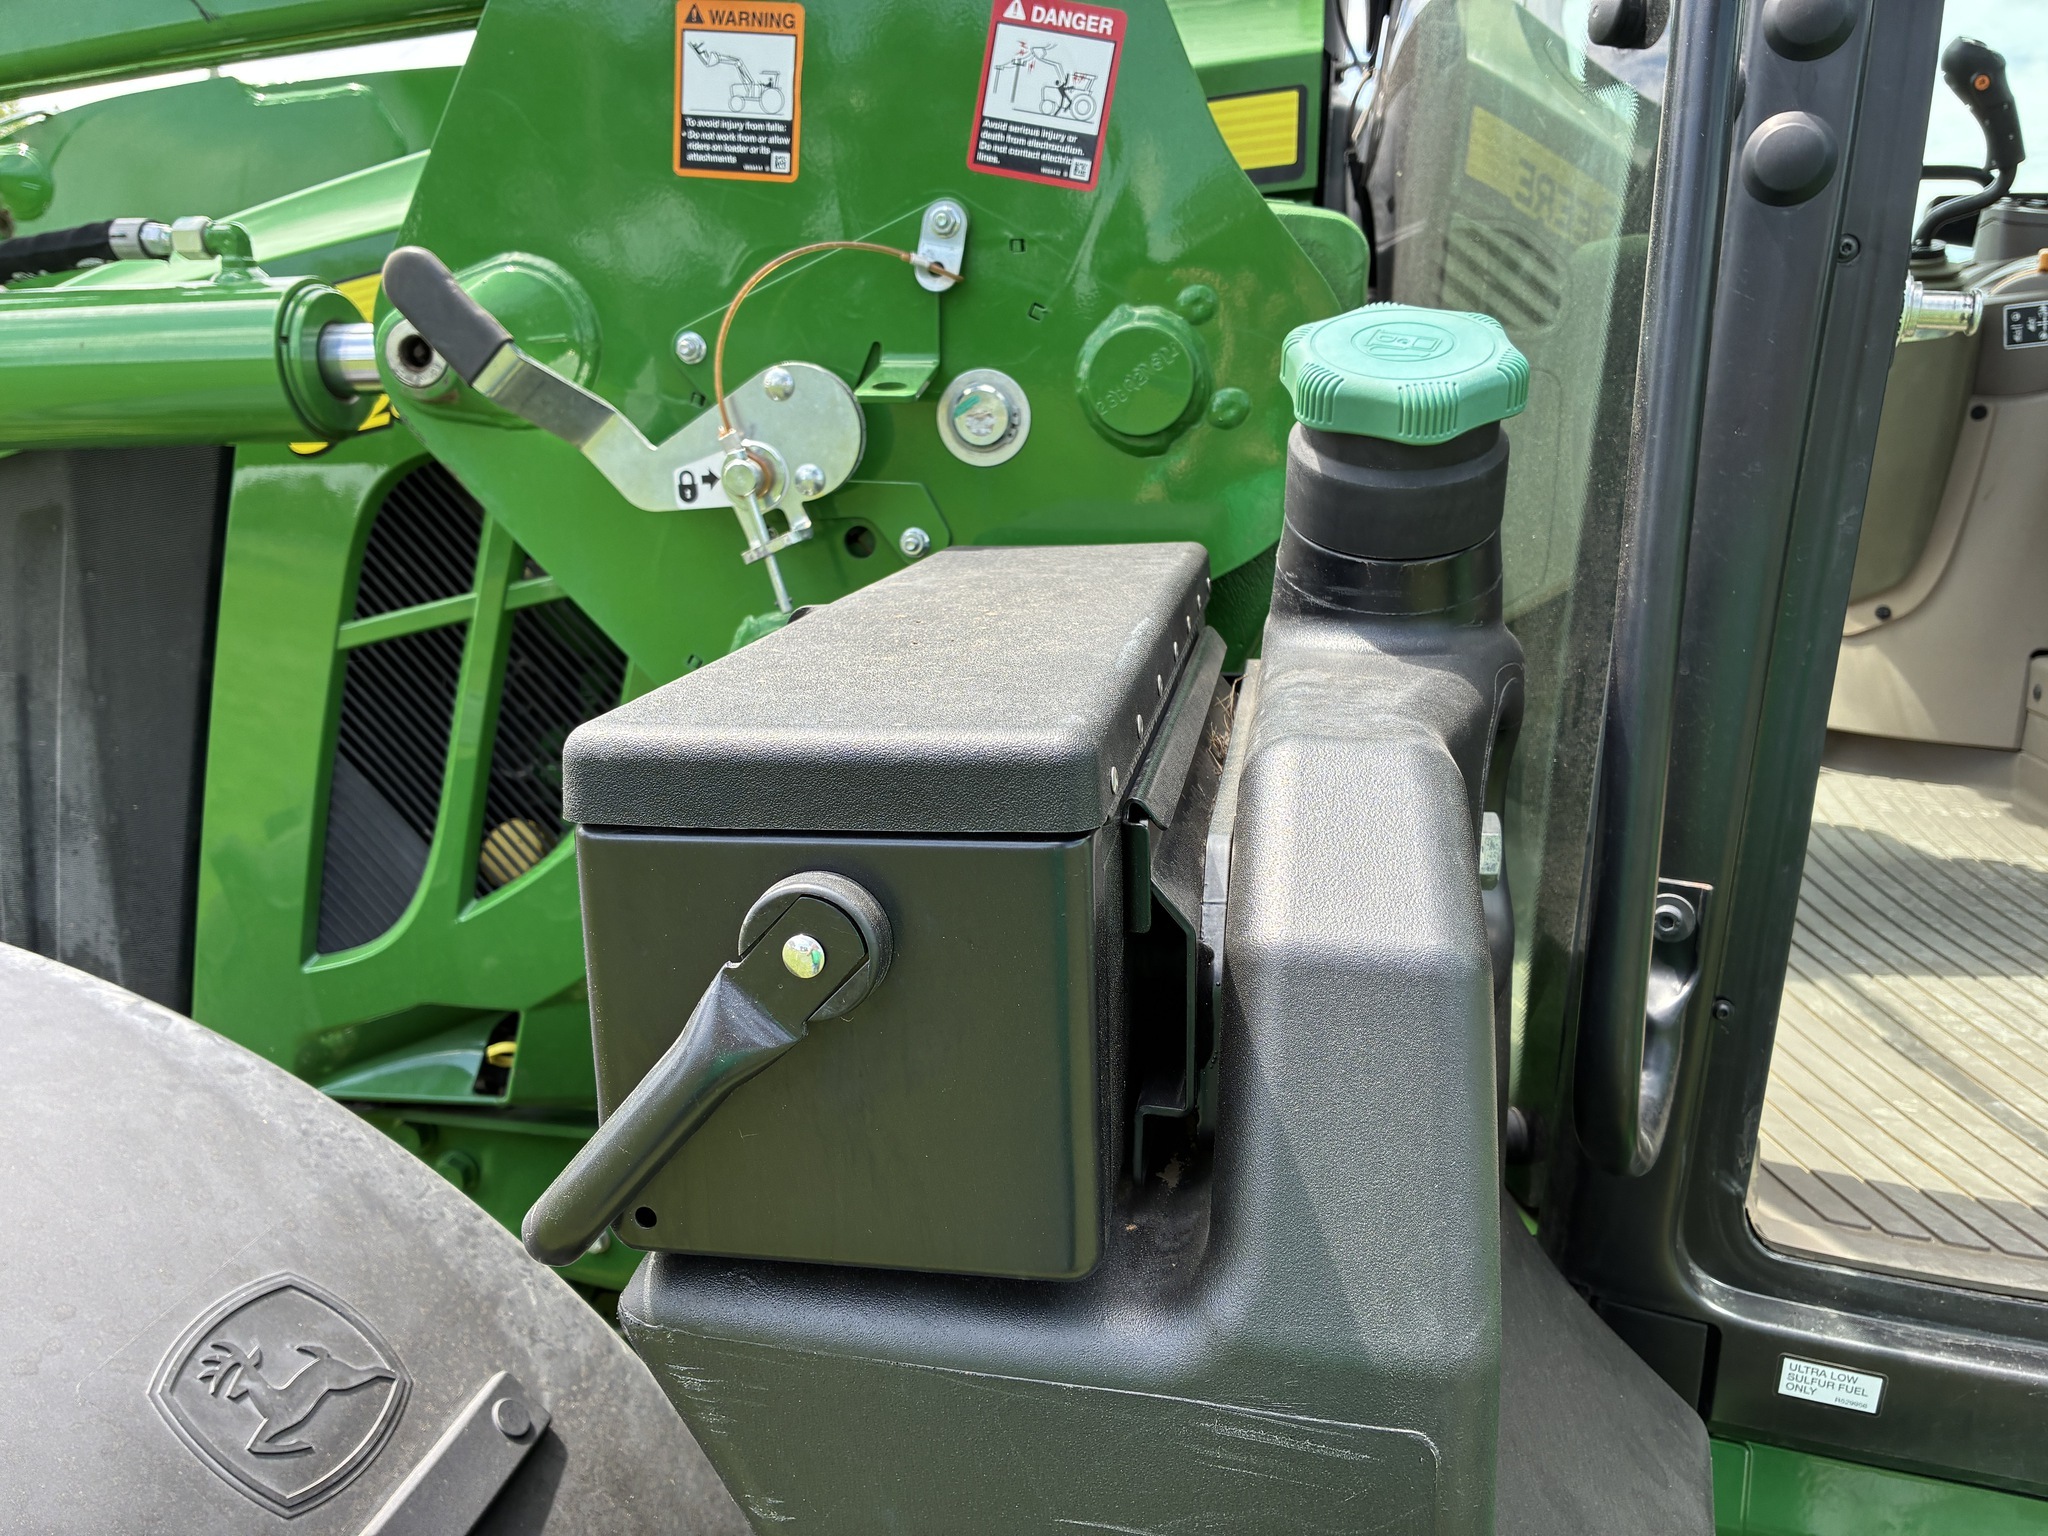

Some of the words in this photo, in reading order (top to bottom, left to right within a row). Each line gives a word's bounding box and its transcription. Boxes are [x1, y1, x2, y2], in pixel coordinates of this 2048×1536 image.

[708, 9, 796, 29] WARNING
[1031, 5, 1114, 35] DANGER
[684, 117, 696, 127] To
[697, 118, 720, 129] avoid
[721, 119, 744, 132] injury
[745, 121, 765, 131] from
[982, 119, 1007, 132] Avoid
[1008, 121, 1041, 137] serious
[1041, 126, 1066, 143] injury
[1067, 133, 1078, 143] or
[687, 130, 700, 140] Do
[701, 131, 715, 141] not
[716, 131, 736, 142] work
[737, 132, 757, 142] from
[757, 135, 767, 144] or
[768, 134, 790, 145] allow
[687, 141, 710, 151] riders
[710, 143, 722, 152] on
[723, 143, 749, 153] loader
[749, 146, 759, 154] or
[760, 145, 771, 154] its
[980, 131, 1005, 142] death
[1006, 134, 1026, 146] from
[1027, 138, 1085, 156] electrocution.
[976, 152, 1000, 164] lines.
[979, 141, 992, 151] Do
[993, 143, 1007, 153] not
[1008, 146, 1040, 160] contact
[1041, 151, 1073, 166] electric
[1789, 1362, 1827, 1378] ULTRA
[1830, 1371, 1859, 1384] LOW
[1785, 1382, 1817, 1396] ONLY
[1787, 1372, 1835, 1390] SULFUR
[1838, 1383, 1869, 1397] FUEL
